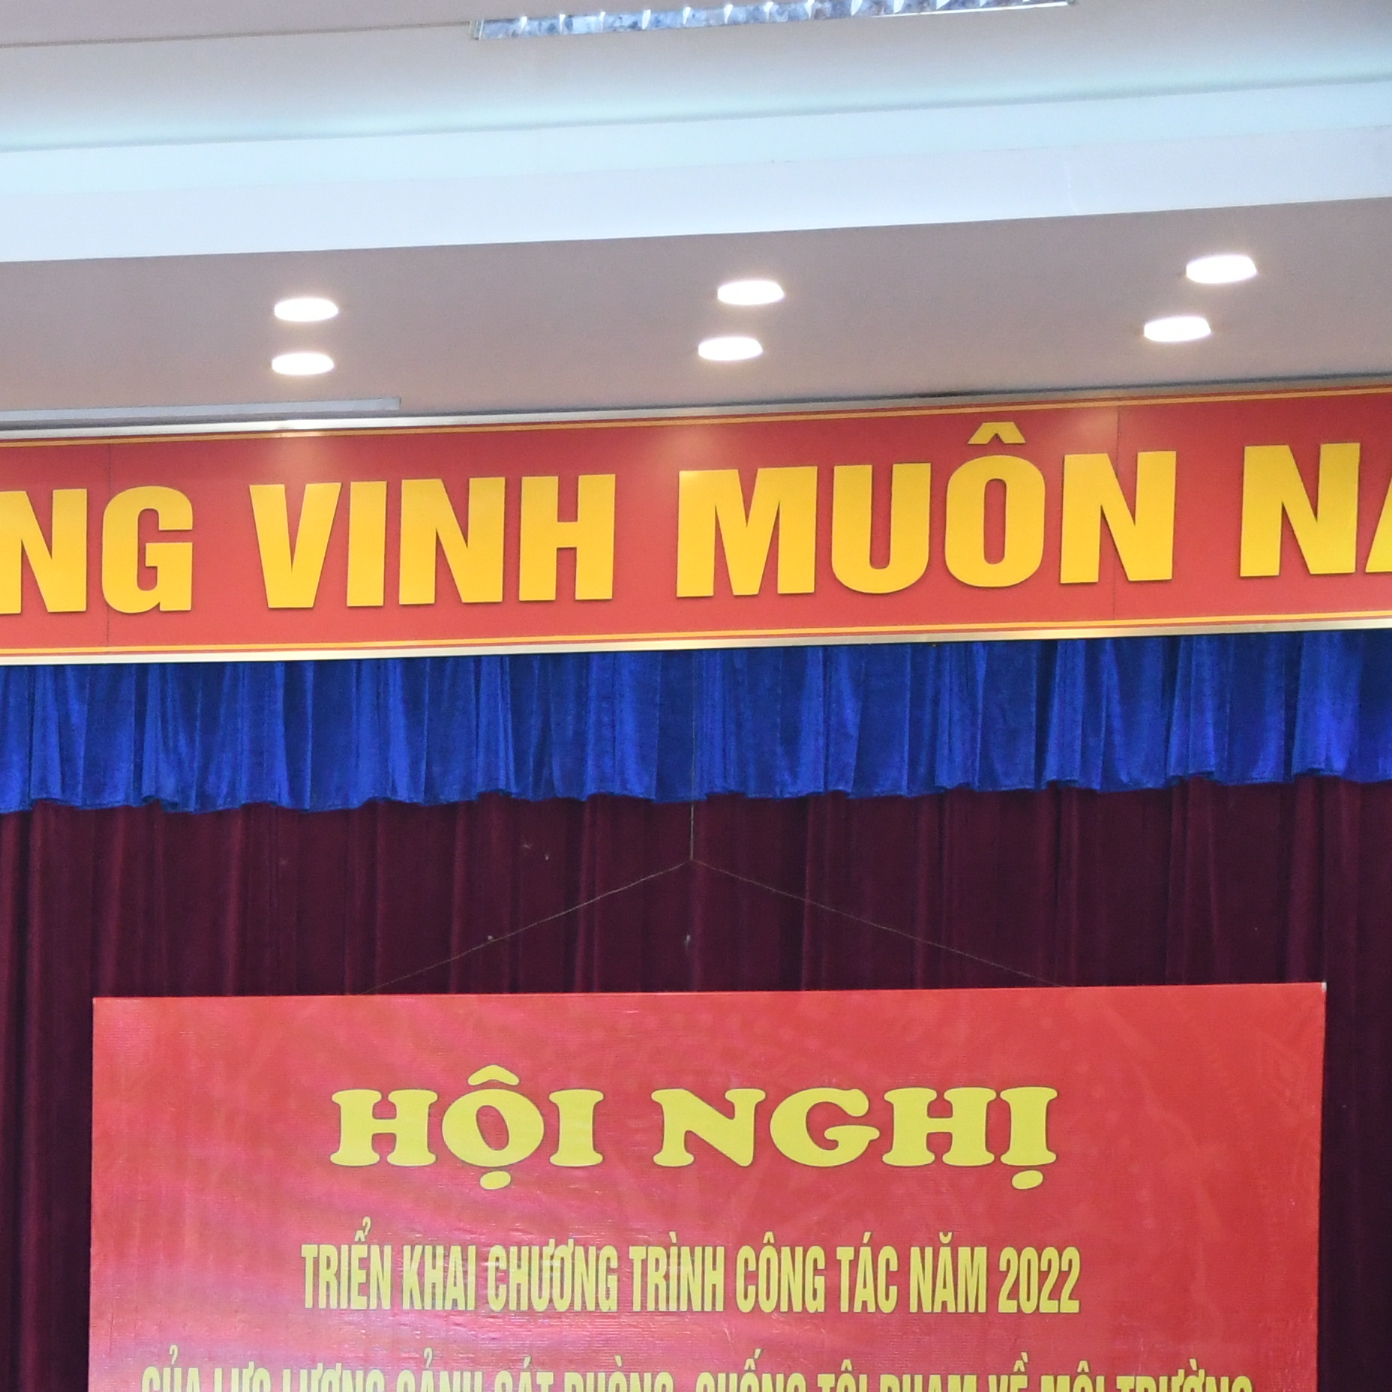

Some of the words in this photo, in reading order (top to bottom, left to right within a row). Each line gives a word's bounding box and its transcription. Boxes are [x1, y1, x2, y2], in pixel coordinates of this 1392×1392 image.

[250, 474, 615, 608] VINH
[677, 423, 1176, 597] MUÔN
[1240, 443, 1392, 576] N
[331, 1065, 603, 1189] HỘI
[652, 1087, 1057, 1189] NGHỊ
[302, 1217, 391, 1309] TRIỂN
[403, 1245, 476, 1310] KHAI
[487, 1239, 618, 1312] CHƯƠNG
[630, 1232, 724, 1311] TRÌNH
[736, 1232, 825, 1312] CÔNG
[837, 1232, 898, 1313] TÁC
[910, 1233, 987, 1312] NĂM
[999, 1247, 1080, 1313] 2022
